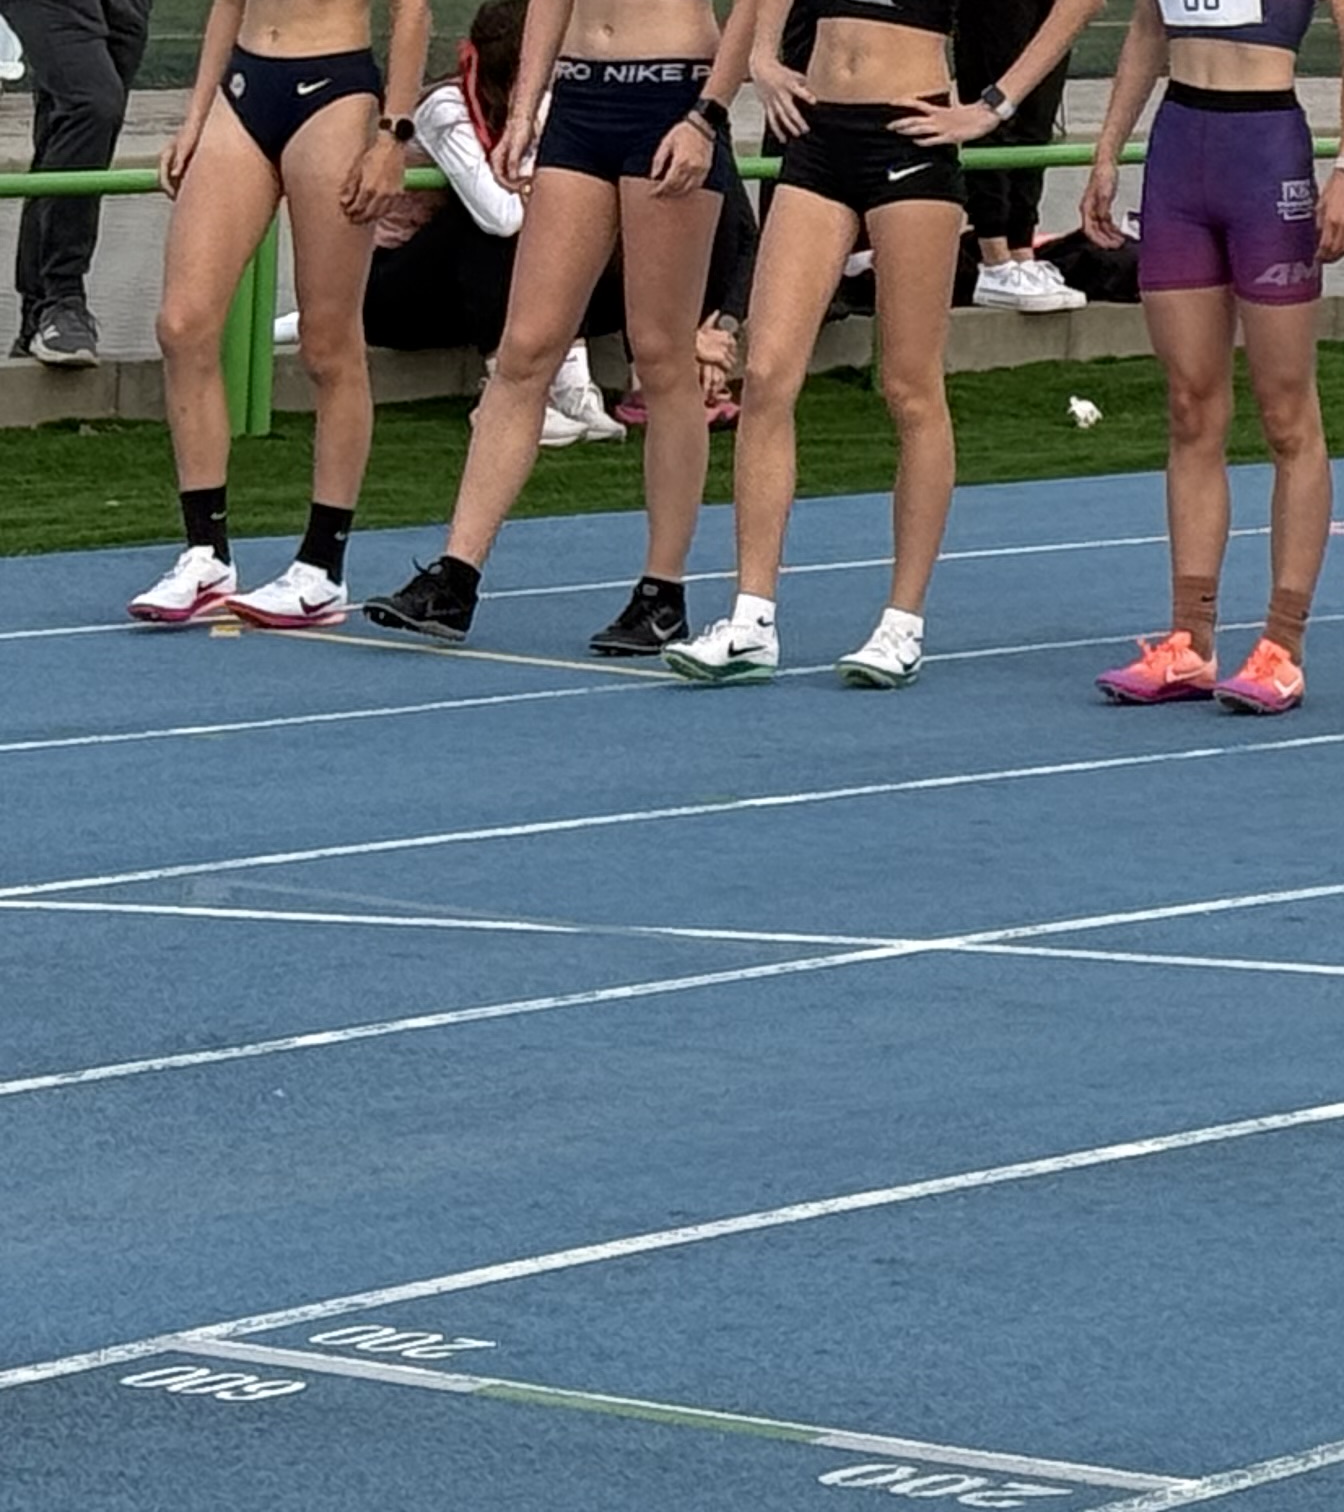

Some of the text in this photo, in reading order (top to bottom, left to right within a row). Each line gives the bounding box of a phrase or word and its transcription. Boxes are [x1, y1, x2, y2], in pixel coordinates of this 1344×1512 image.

[603, 63, 686, 82] NIKE
[309, 1325, 496, 1359] 200
[120, 1366, 306, 1400] 600
[818, 1463, 1073, 1508] 200
